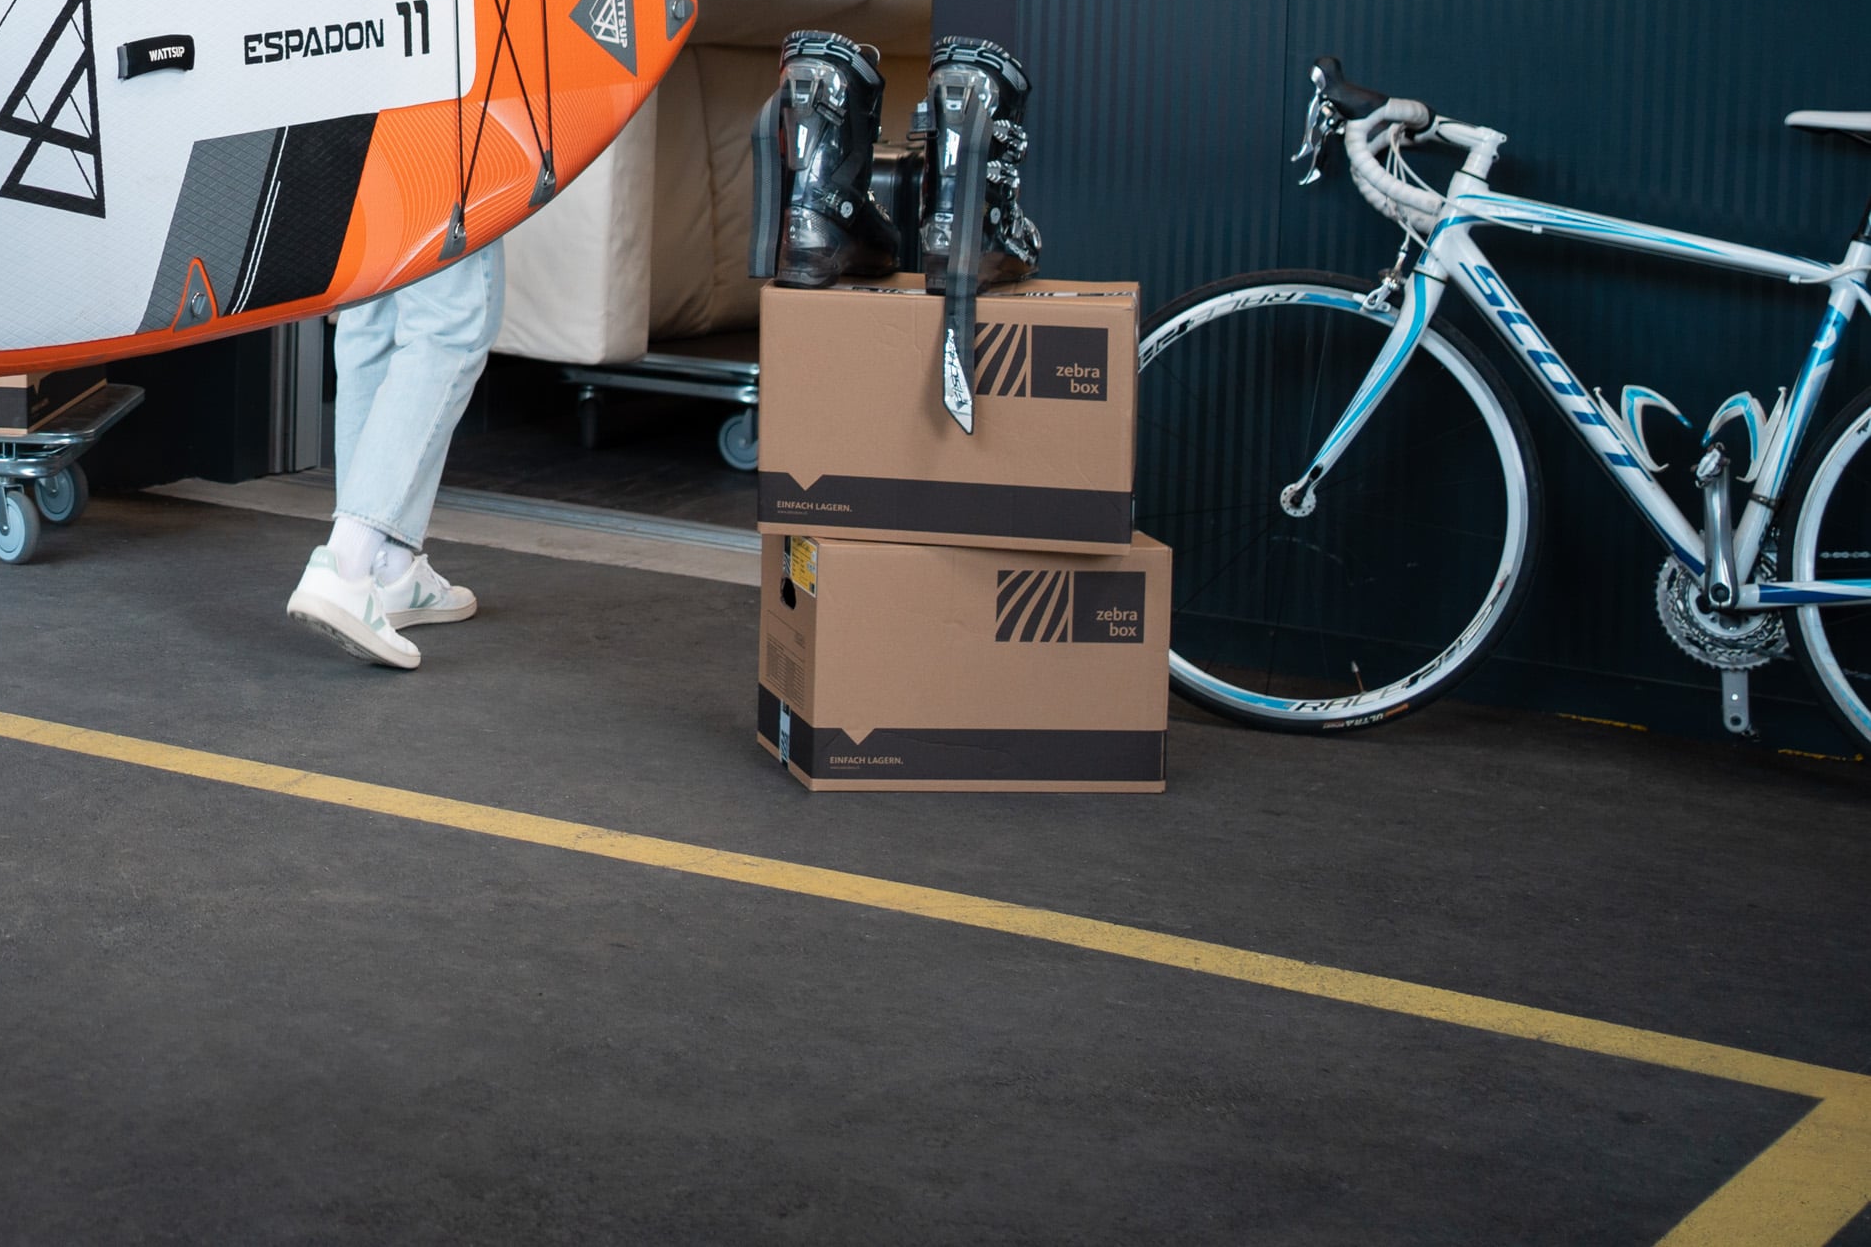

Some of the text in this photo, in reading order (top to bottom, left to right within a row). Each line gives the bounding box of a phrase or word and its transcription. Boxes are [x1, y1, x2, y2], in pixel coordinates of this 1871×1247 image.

[244, 0, 430, 65] ESPADON 11
[148, 46, 185, 62] WATTSUP
[1055, 362, 1100, 378] zebra
[1458, 262, 1653, 482] SCOTT
[1070, 378, 1099, 394] box
[776, 500, 813, 510] EINFACH
[815, 503, 853, 513] LAGERN.
[1096, 606, 1138, 621] zebra
[1109, 622, 1137, 637] box
[830, 756, 904, 765] EINFACH LAGERN.
